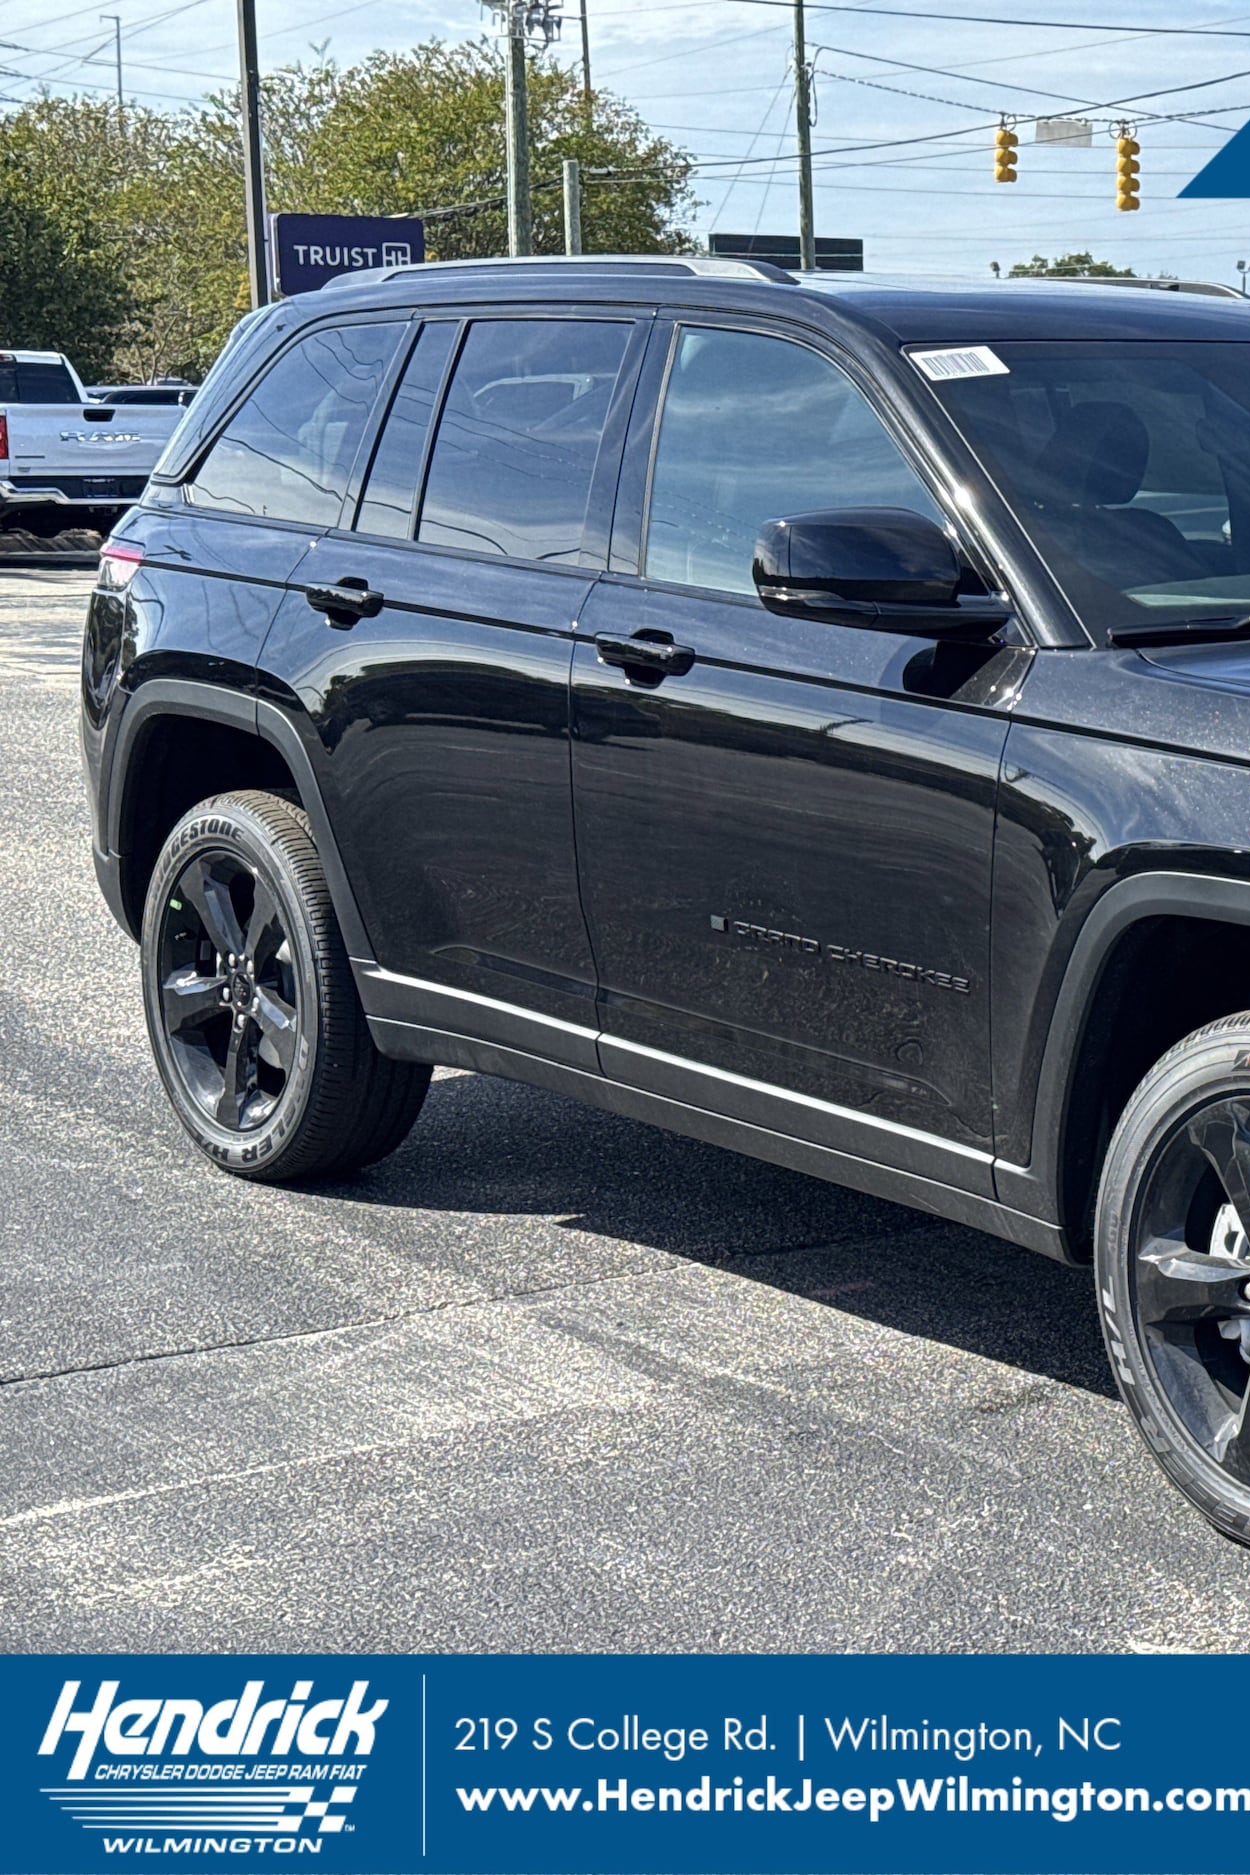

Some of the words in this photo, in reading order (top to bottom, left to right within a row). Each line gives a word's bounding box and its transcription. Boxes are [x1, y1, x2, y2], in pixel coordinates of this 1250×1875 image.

[293, 245, 377, 267] TRUIST
[733, 919, 821, 953] GRAND
[826, 943, 972, 994] CHEROKEE
[1102, 1275, 1135, 1386] H/L
